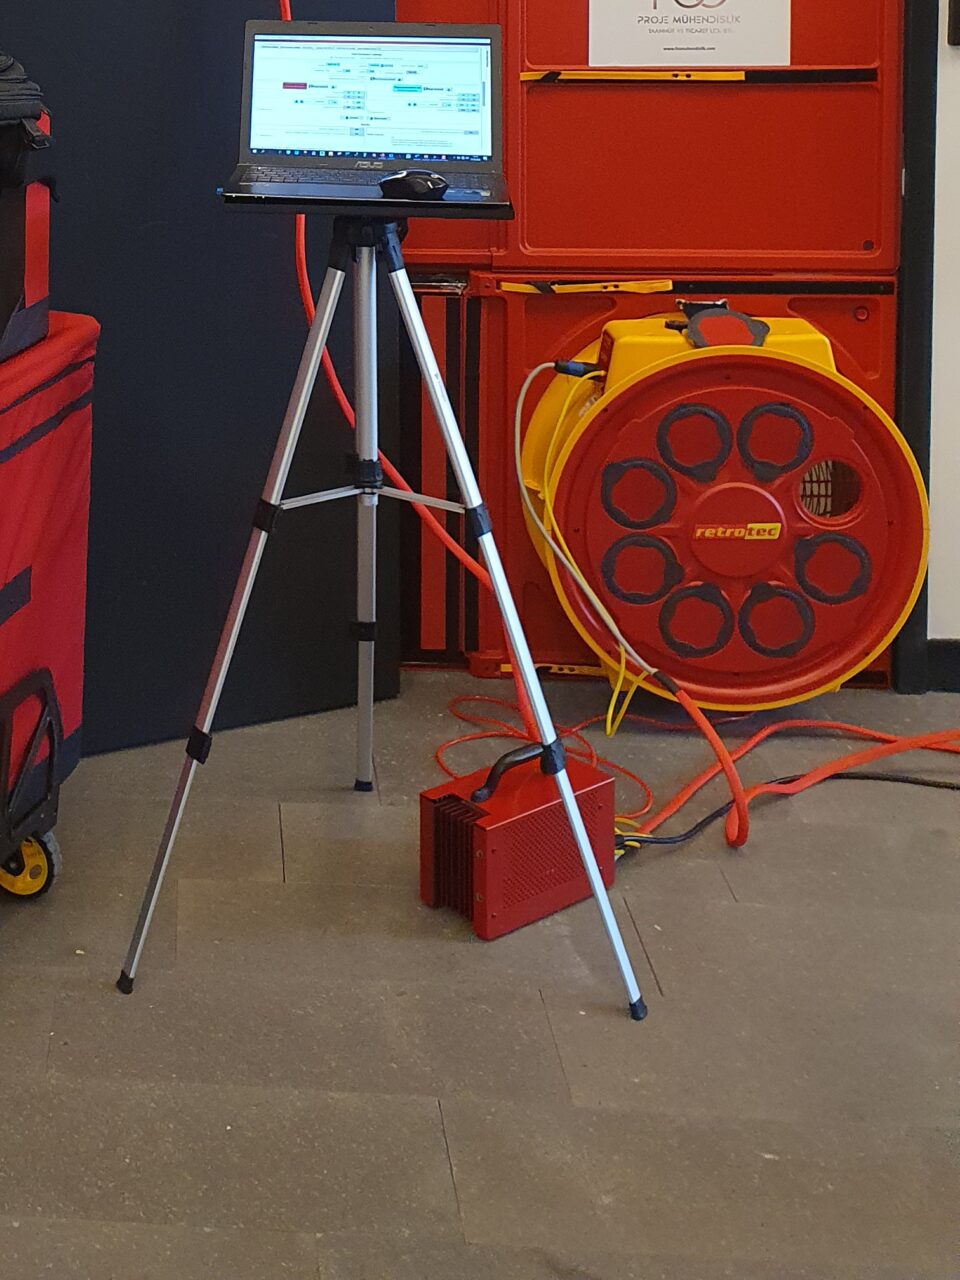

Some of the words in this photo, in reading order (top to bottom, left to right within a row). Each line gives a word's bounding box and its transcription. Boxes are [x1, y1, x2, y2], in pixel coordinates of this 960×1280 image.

[637, 15, 669, 25] PROJE
[672, 14, 742, 25] MÜHENDİSLİK
[355, 160, 384, 169] ASUS
[695, 527, 777, 537] retrotec
